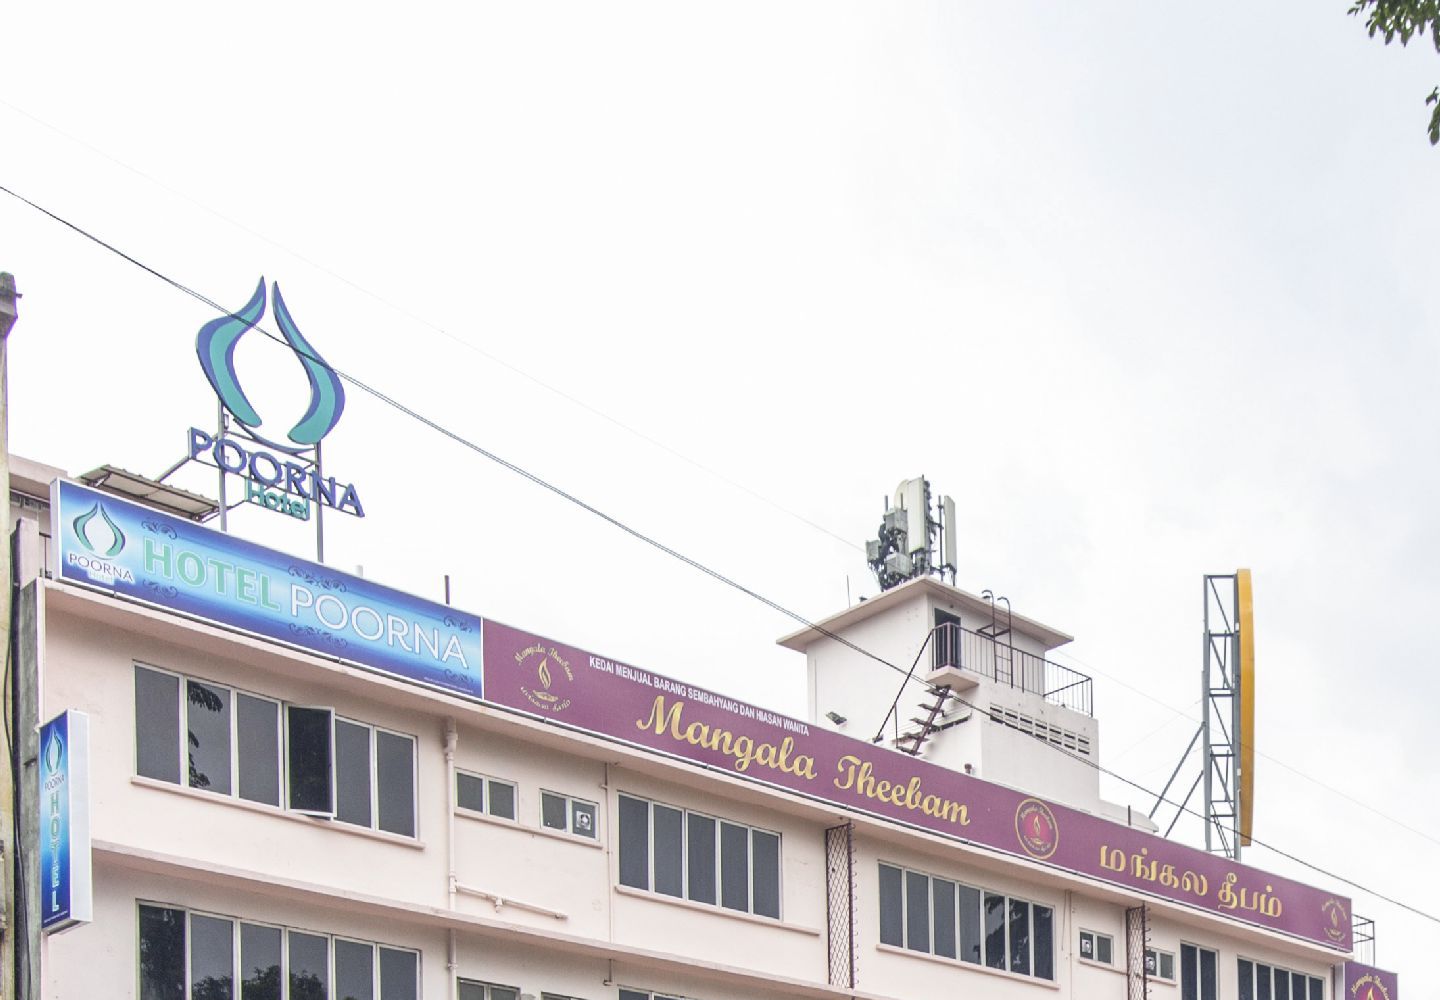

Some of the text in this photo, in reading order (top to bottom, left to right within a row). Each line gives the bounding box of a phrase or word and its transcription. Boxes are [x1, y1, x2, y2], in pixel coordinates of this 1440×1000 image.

[187, 427, 365, 518] POORNA
[245, 477, 311, 521] Hotel
[69, 553, 133, 582] POORNA
[143, 538, 469, 670] HOTEL POORNA
[589, 655, 809, 737] KEDAI MENJUAL BARANG SEMBAHYANG DAN HIASAN WANITA
[636, 695, 970, 826] Mangala Theebam
[1099, 845, 1283, 918] மங்கல தீபம்
